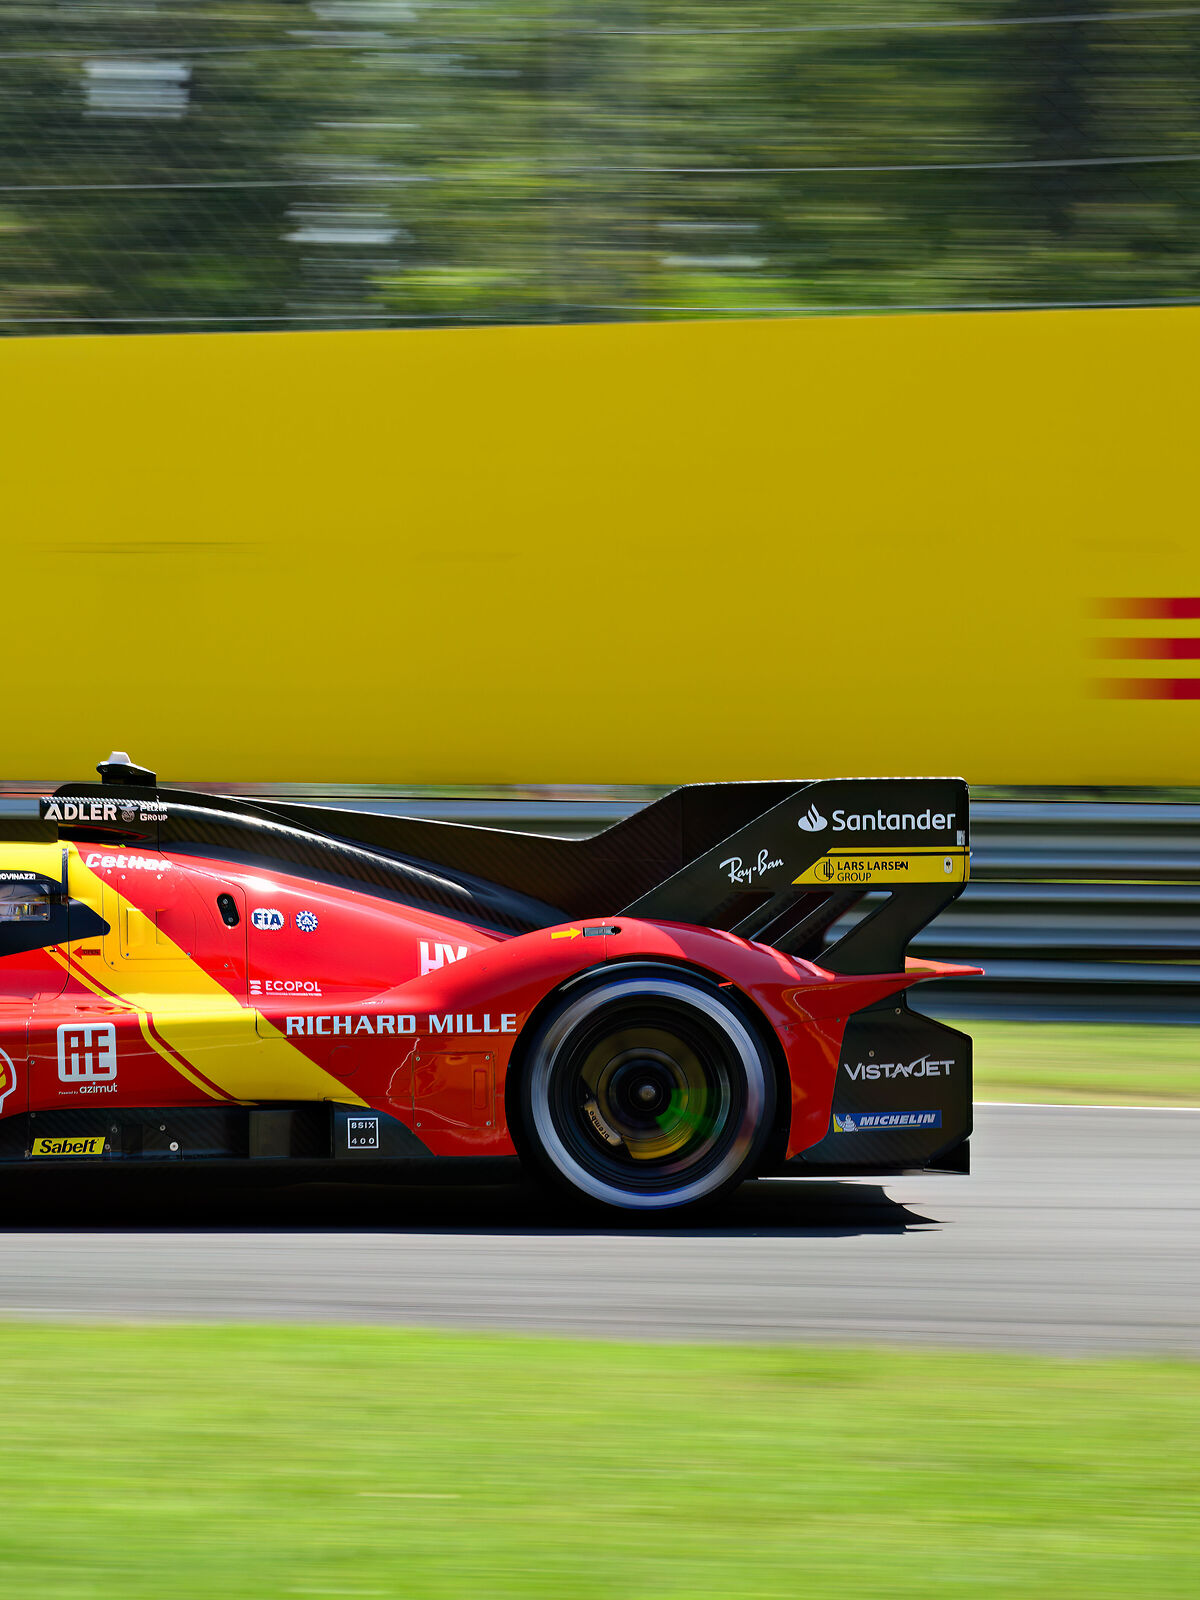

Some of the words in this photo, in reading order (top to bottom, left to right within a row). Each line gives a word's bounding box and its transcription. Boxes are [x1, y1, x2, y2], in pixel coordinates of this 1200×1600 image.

[44, 803, 117, 821] ADLER
[140, 813, 168, 821] GROUP
[832, 809, 956, 831] Santander
[837, 861, 865, 871] LARS
[867, 861, 909, 871] LARSEN
[837, 872, 872, 882] GROUP
[265, 980, 322, 992] ECOPOL
[286, 1014, 416, 1036] RICHARD
[428, 1013, 518, 1034] MILLE
[844, 1054, 955, 1081] VISTAJET
[79, 1081, 118, 1094] azimut
[590, 1110, 610, 1140] brembo
[860, 1113, 936, 1127] MICHELIN
[40, 1139, 99, 1154] Sabelt
